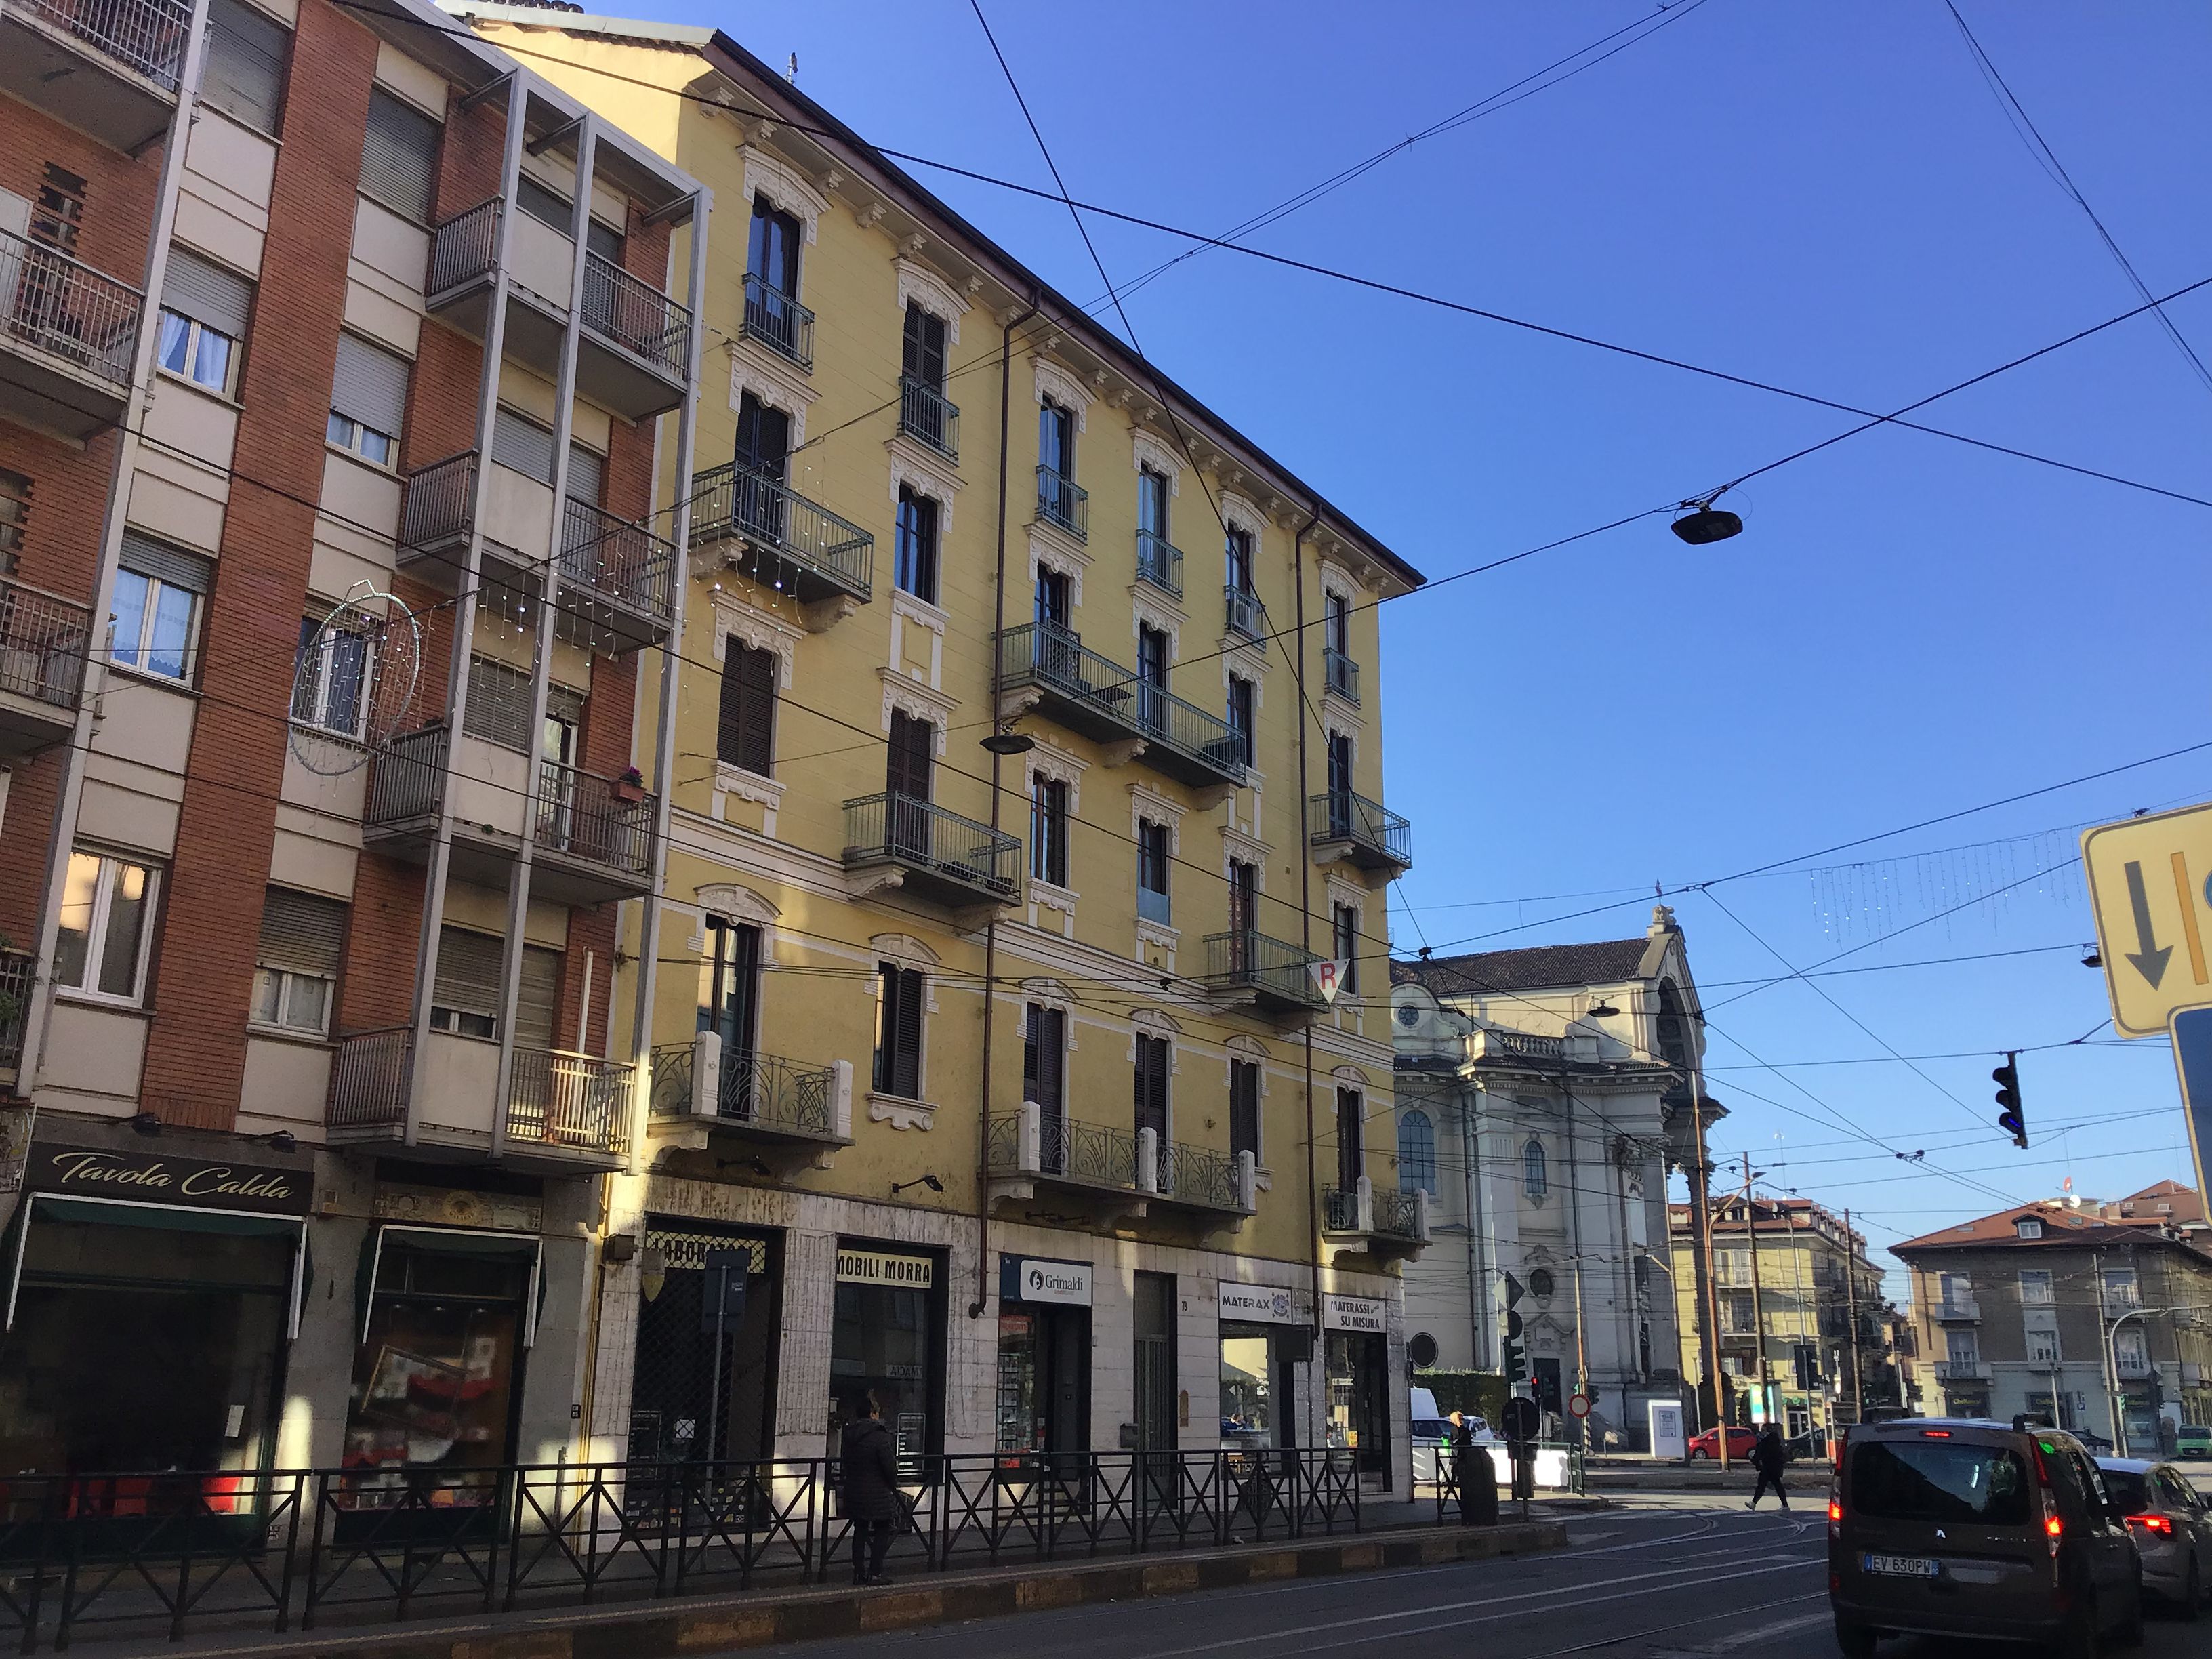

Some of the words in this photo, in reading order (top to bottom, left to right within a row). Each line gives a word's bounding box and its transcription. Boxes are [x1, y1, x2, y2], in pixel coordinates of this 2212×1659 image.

[1320, 963, 1336, 989] R
[52, 1152, 174, 1187] Tavola
[181, 1166, 294, 1199] Calda
[837, 1256, 880, 1278] MOBILI
[884, 1260, 930, 1283] MORRA
[1045, 1275, 1083, 1291] Grimaldi
[1222, 1295, 1270, 1309] MATERAX
[1330, 1300, 1370, 1315] MATERASSI
[1340, 1315, 1351, 1327] SU
[1352, 1316, 1380, 1329] MISURA
[1873, 1557, 1888, 1570] EV
